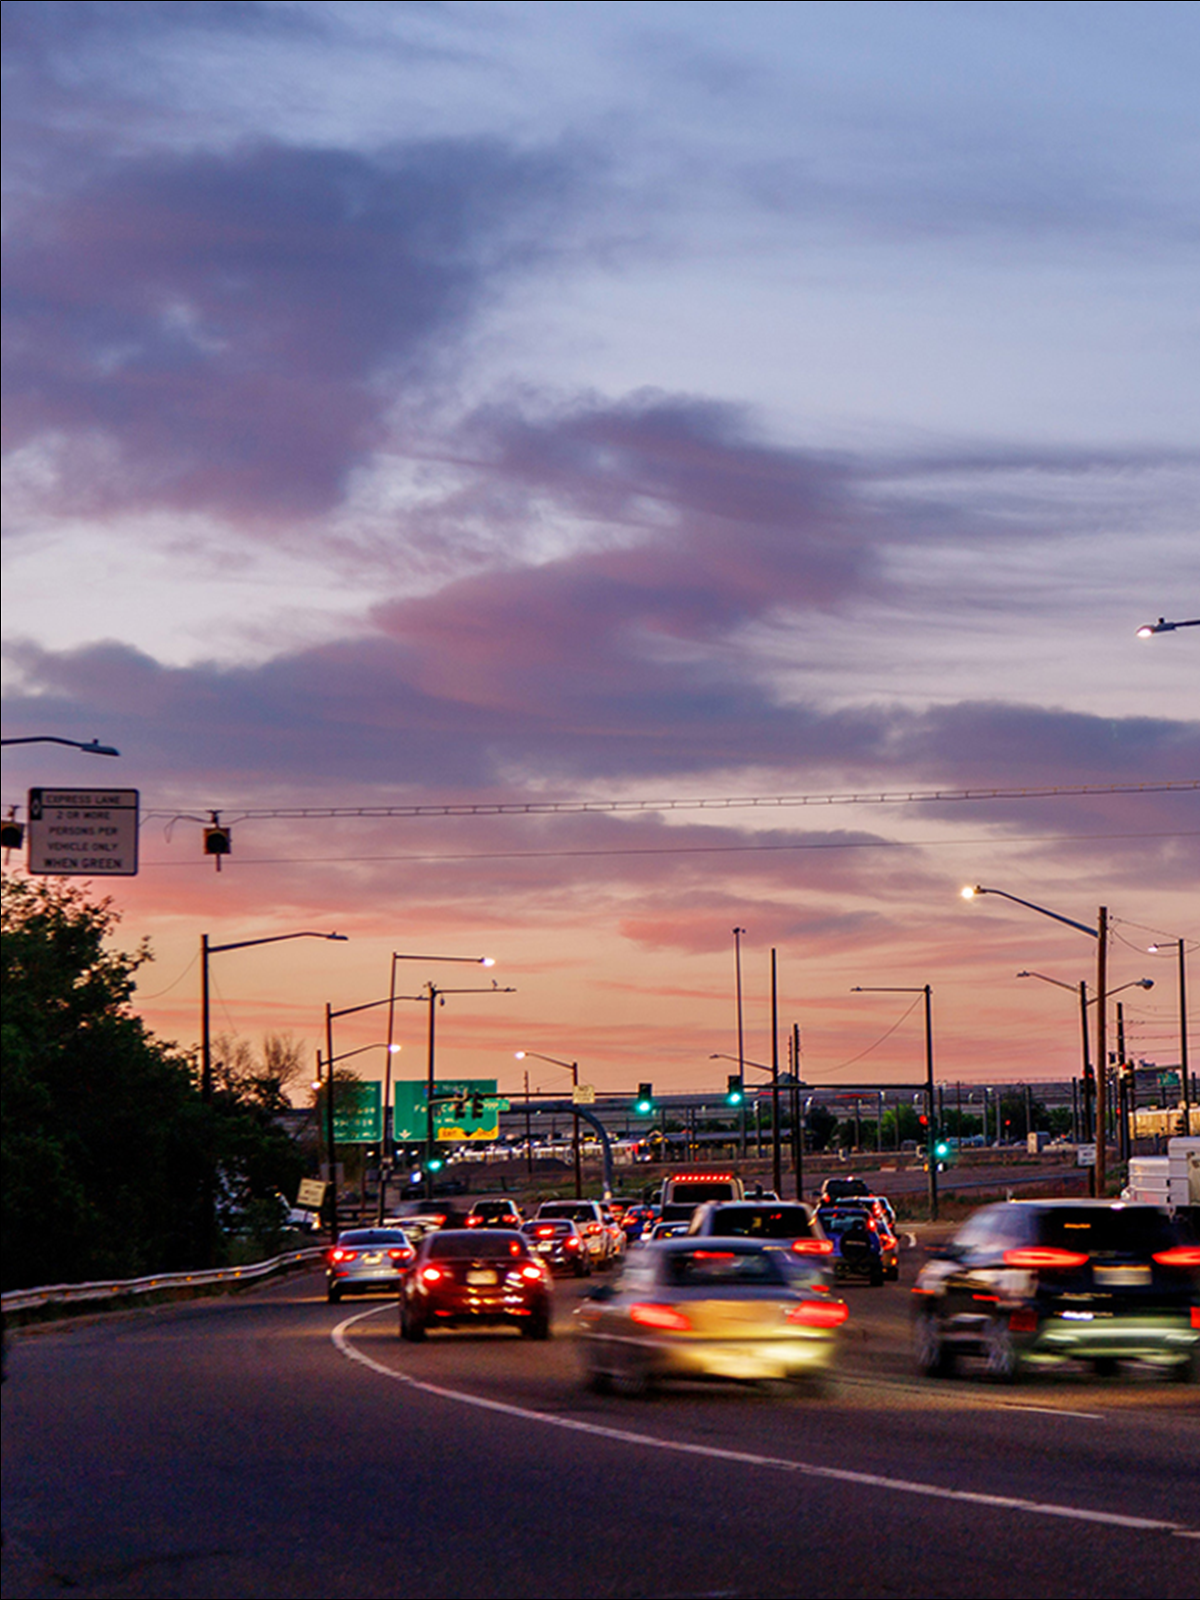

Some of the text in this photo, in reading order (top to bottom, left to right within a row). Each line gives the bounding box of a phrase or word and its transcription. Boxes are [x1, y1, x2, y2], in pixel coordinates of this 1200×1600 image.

[46, 794, 121, 804] EXPRESS LANE
[56, 810, 110, 820] 2 OR MORE
[48, 826, 118, 836] PERSONS PER
[47, 842, 118, 851] VEHICLE ONLY
[43, 858, 122, 869] WHEN GREEN
